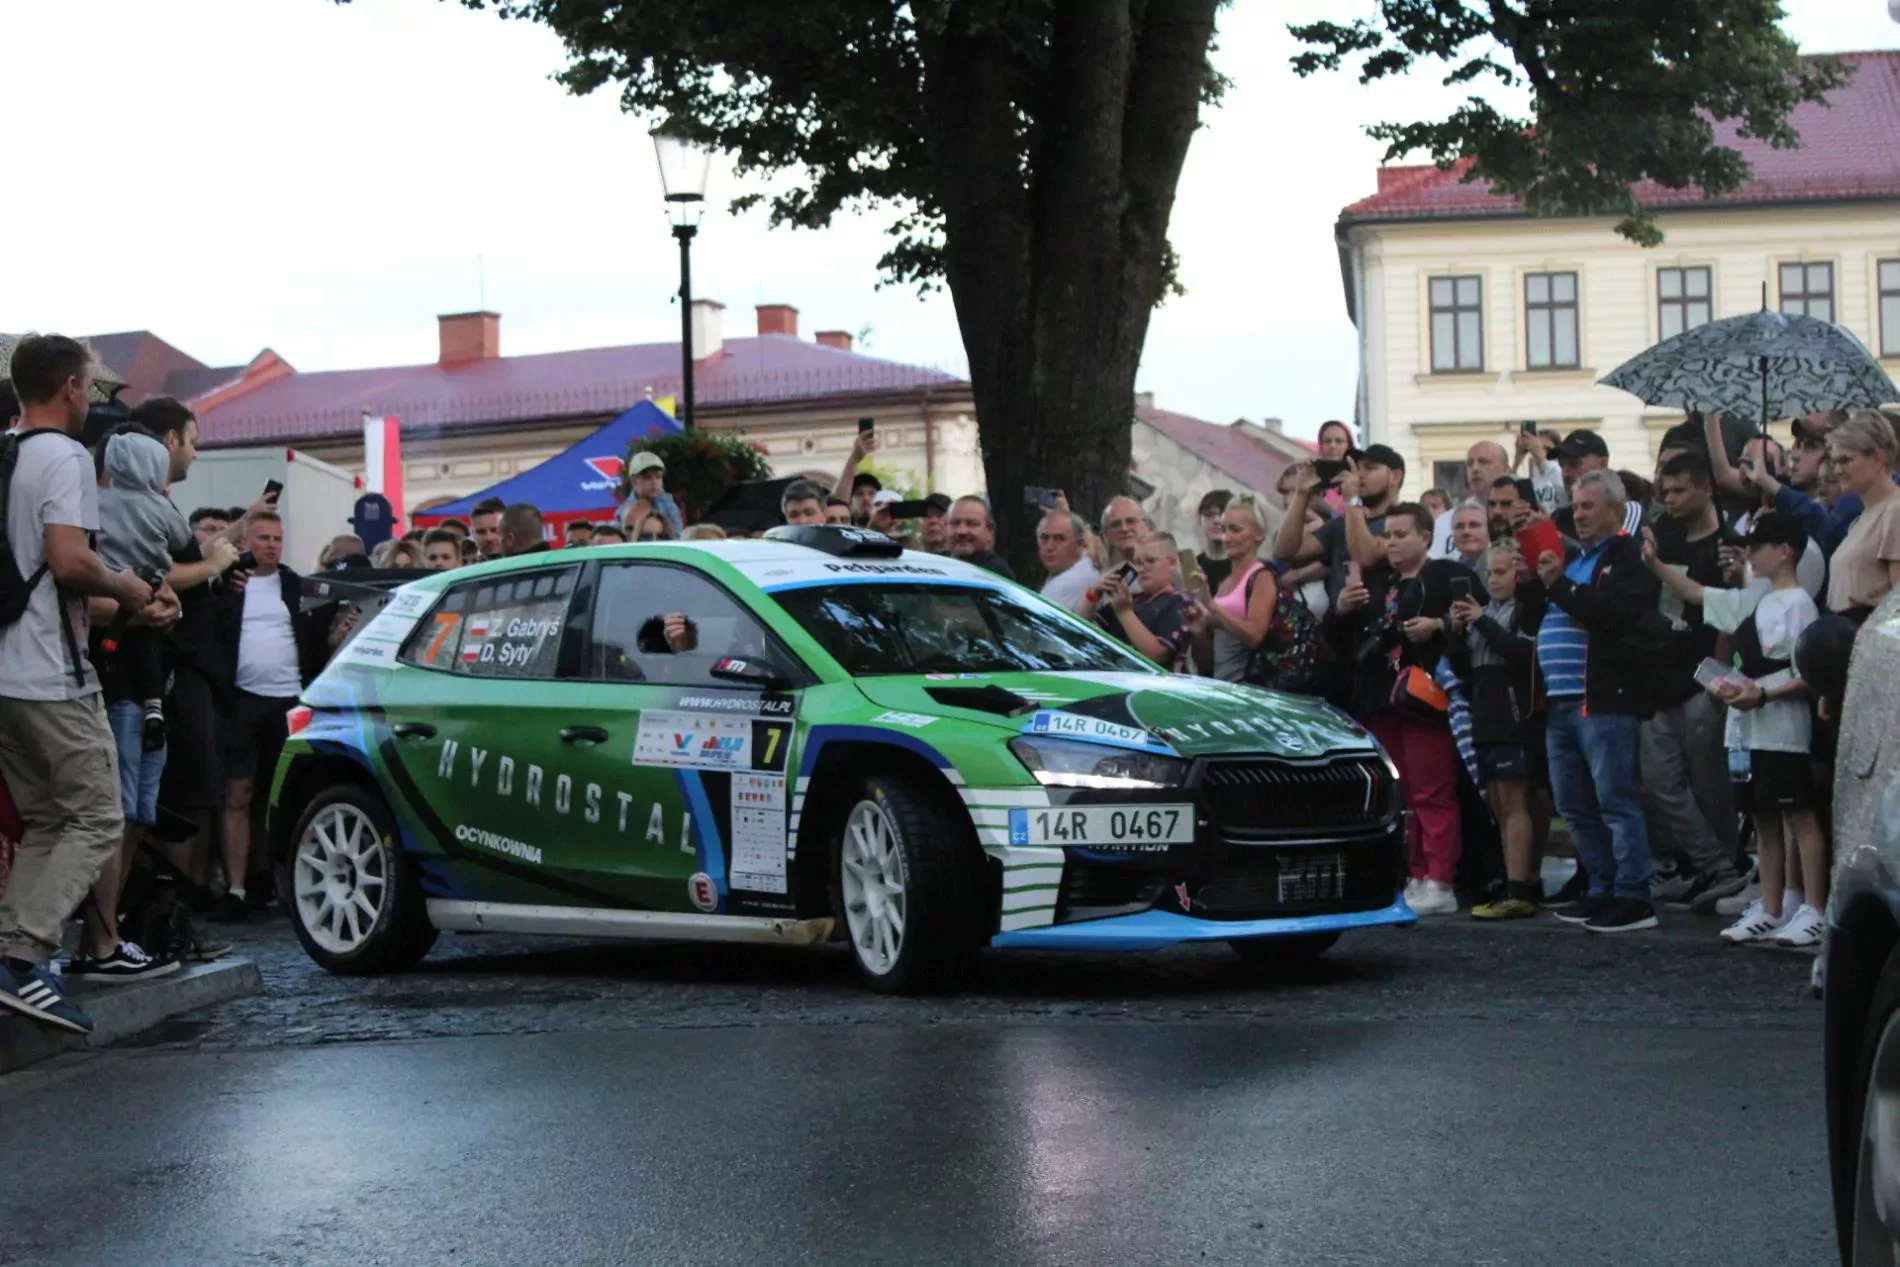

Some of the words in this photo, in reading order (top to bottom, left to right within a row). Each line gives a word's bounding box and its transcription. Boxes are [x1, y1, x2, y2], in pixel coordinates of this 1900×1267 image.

[425, 613, 461, 664] 7
[488, 618, 503, 637] Z.
[507, 616, 561, 640] Gabryś
[480, 643, 495, 662] D.
[499, 642, 534, 667] Syty
[679, 696, 792, 712] WWW.HYDROSTAL.PL
[1053, 717, 1086, 733] 14R
[1095, 721, 1141, 740] 0467
[763, 728, 781, 764] 7
[438, 739, 696, 856] HYDROSTAL
[1012, 832, 1027, 841] CZ
[1036, 811, 1087, 841] 14R
[1110, 810, 1180, 840] 0467
[456, 824, 542, 864] OCYNKOWNIA
